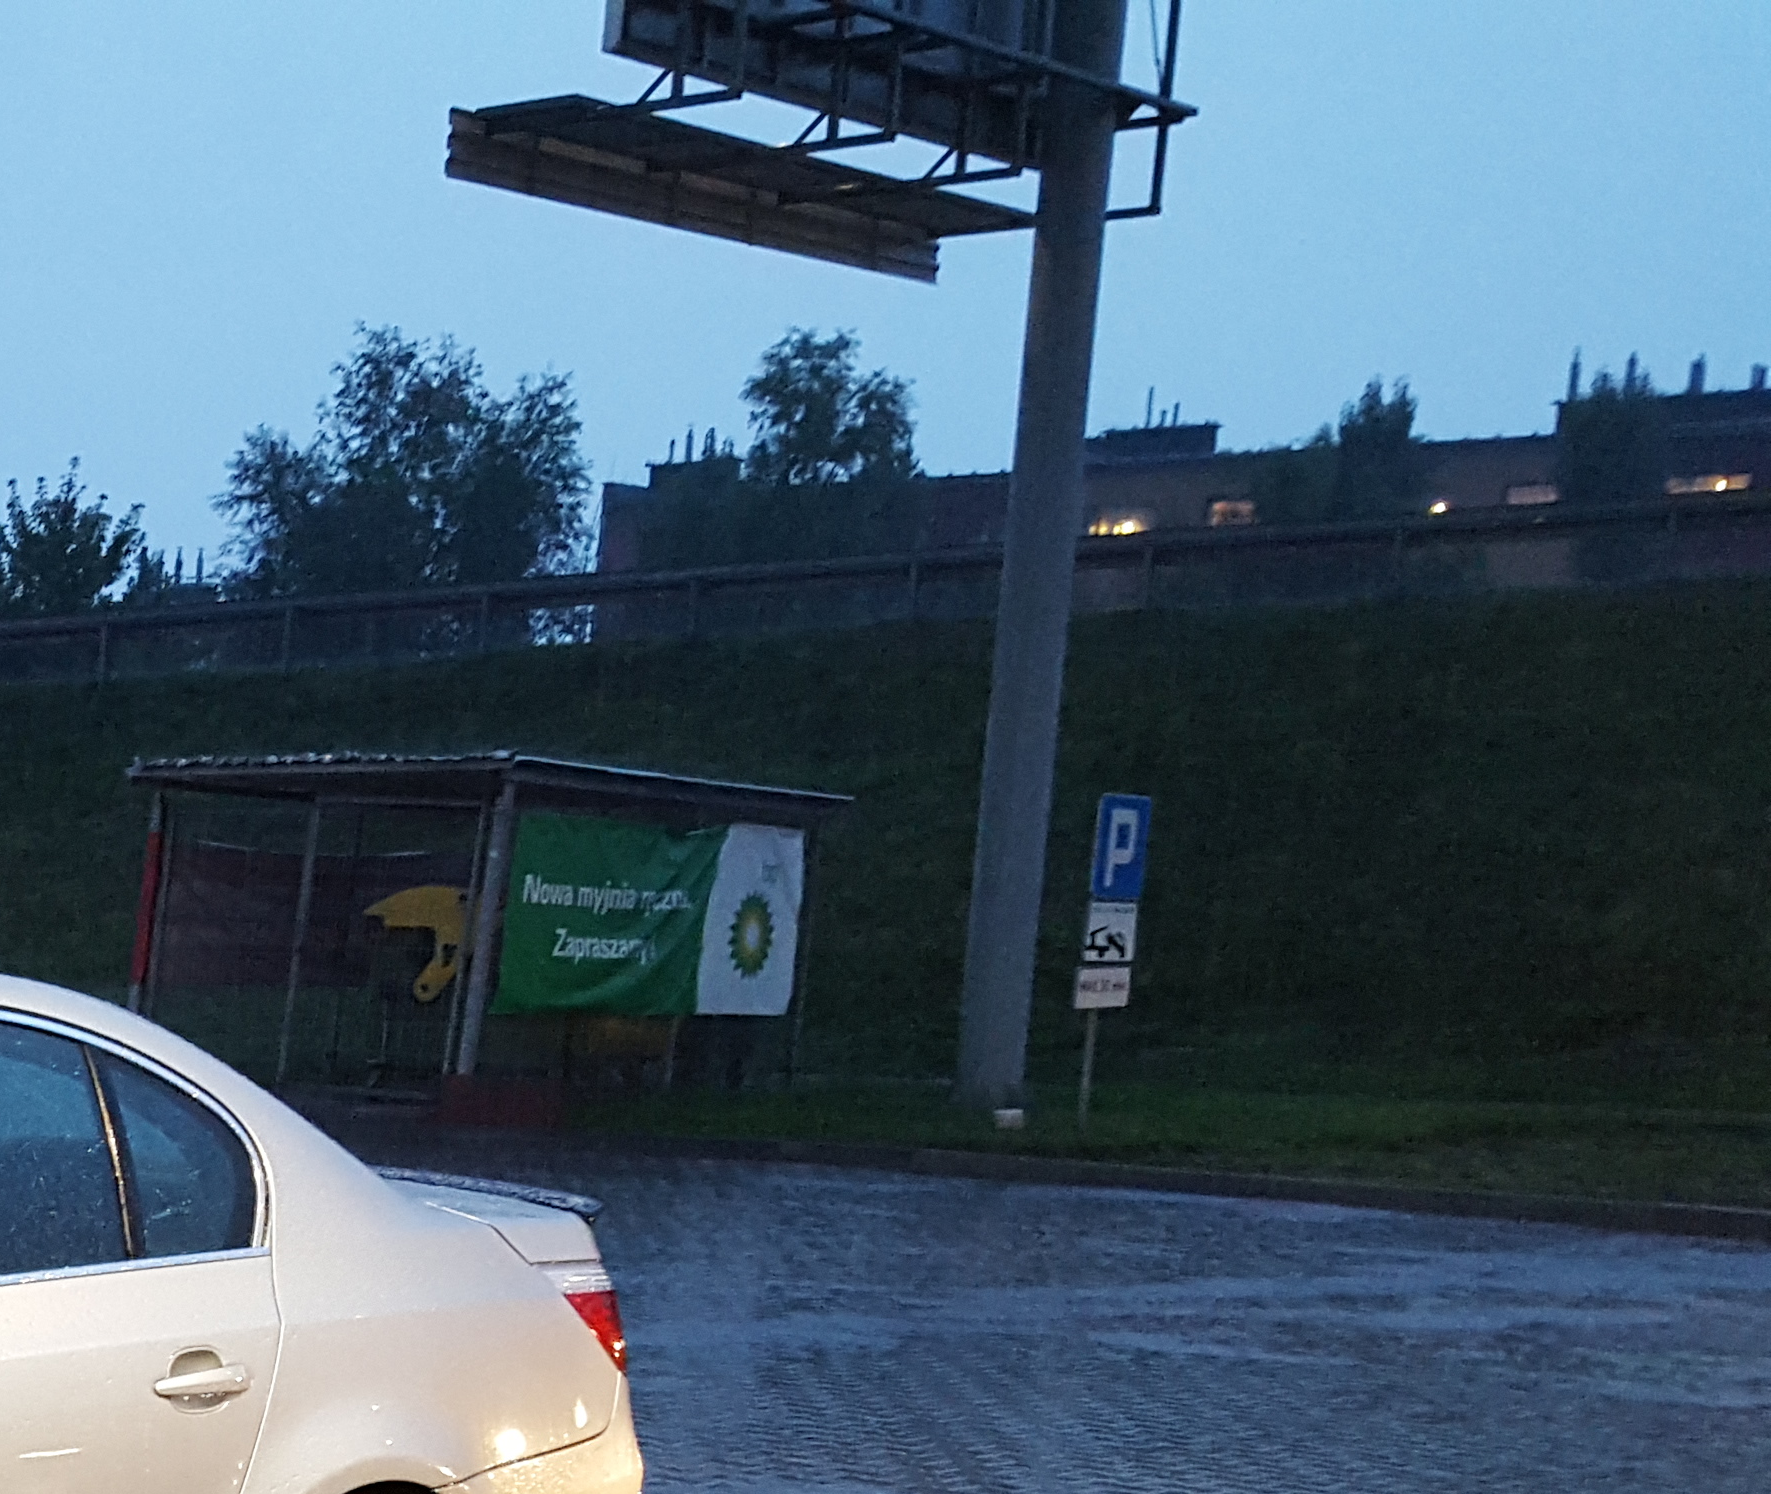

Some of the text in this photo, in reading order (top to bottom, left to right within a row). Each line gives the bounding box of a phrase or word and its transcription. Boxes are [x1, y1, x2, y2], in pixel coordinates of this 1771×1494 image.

[1103, 808, 1139, 888] P
[522, 874, 574, 906] Nowa
[577, 880, 637, 915] myjnia
